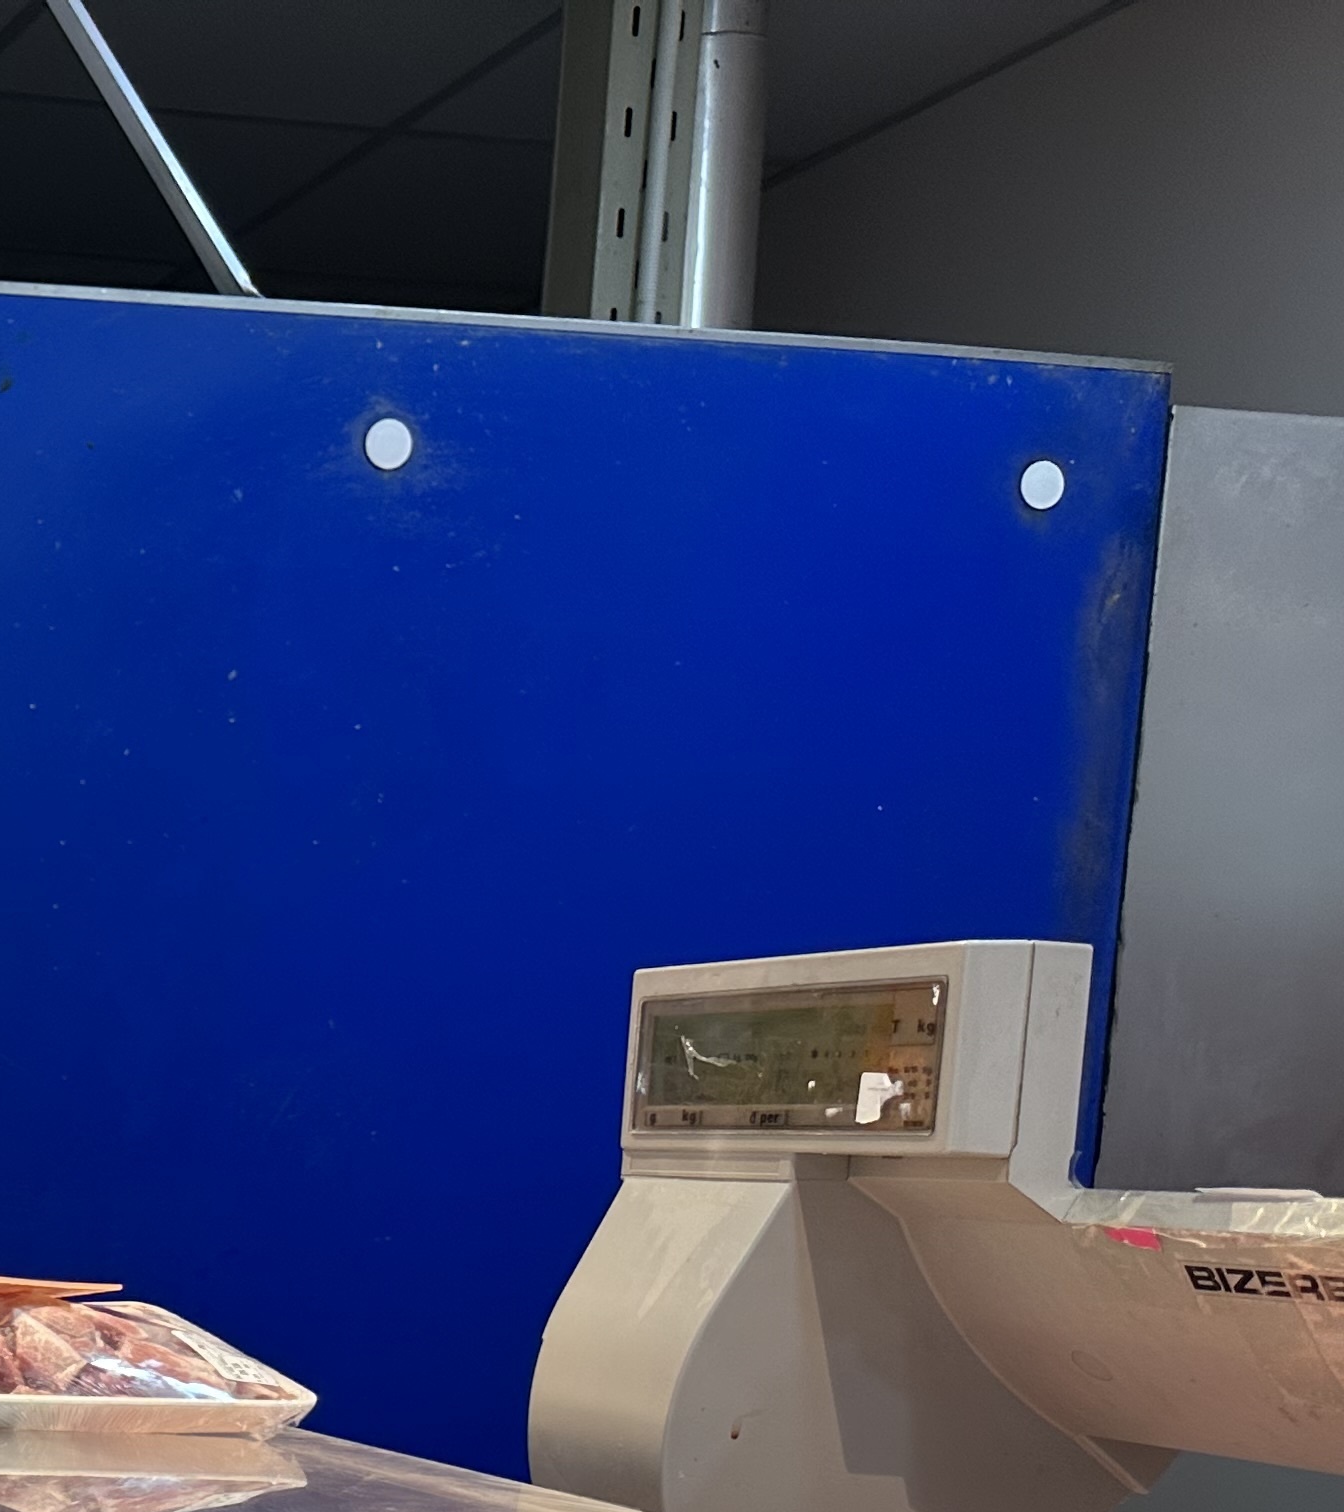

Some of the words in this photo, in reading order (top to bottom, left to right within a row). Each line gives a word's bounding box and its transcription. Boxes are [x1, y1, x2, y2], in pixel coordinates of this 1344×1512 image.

[916, 1017, 936, 1037] kg
[681, 1109, 698, 1125] kg
[759, 1112, 780, 1126] per
